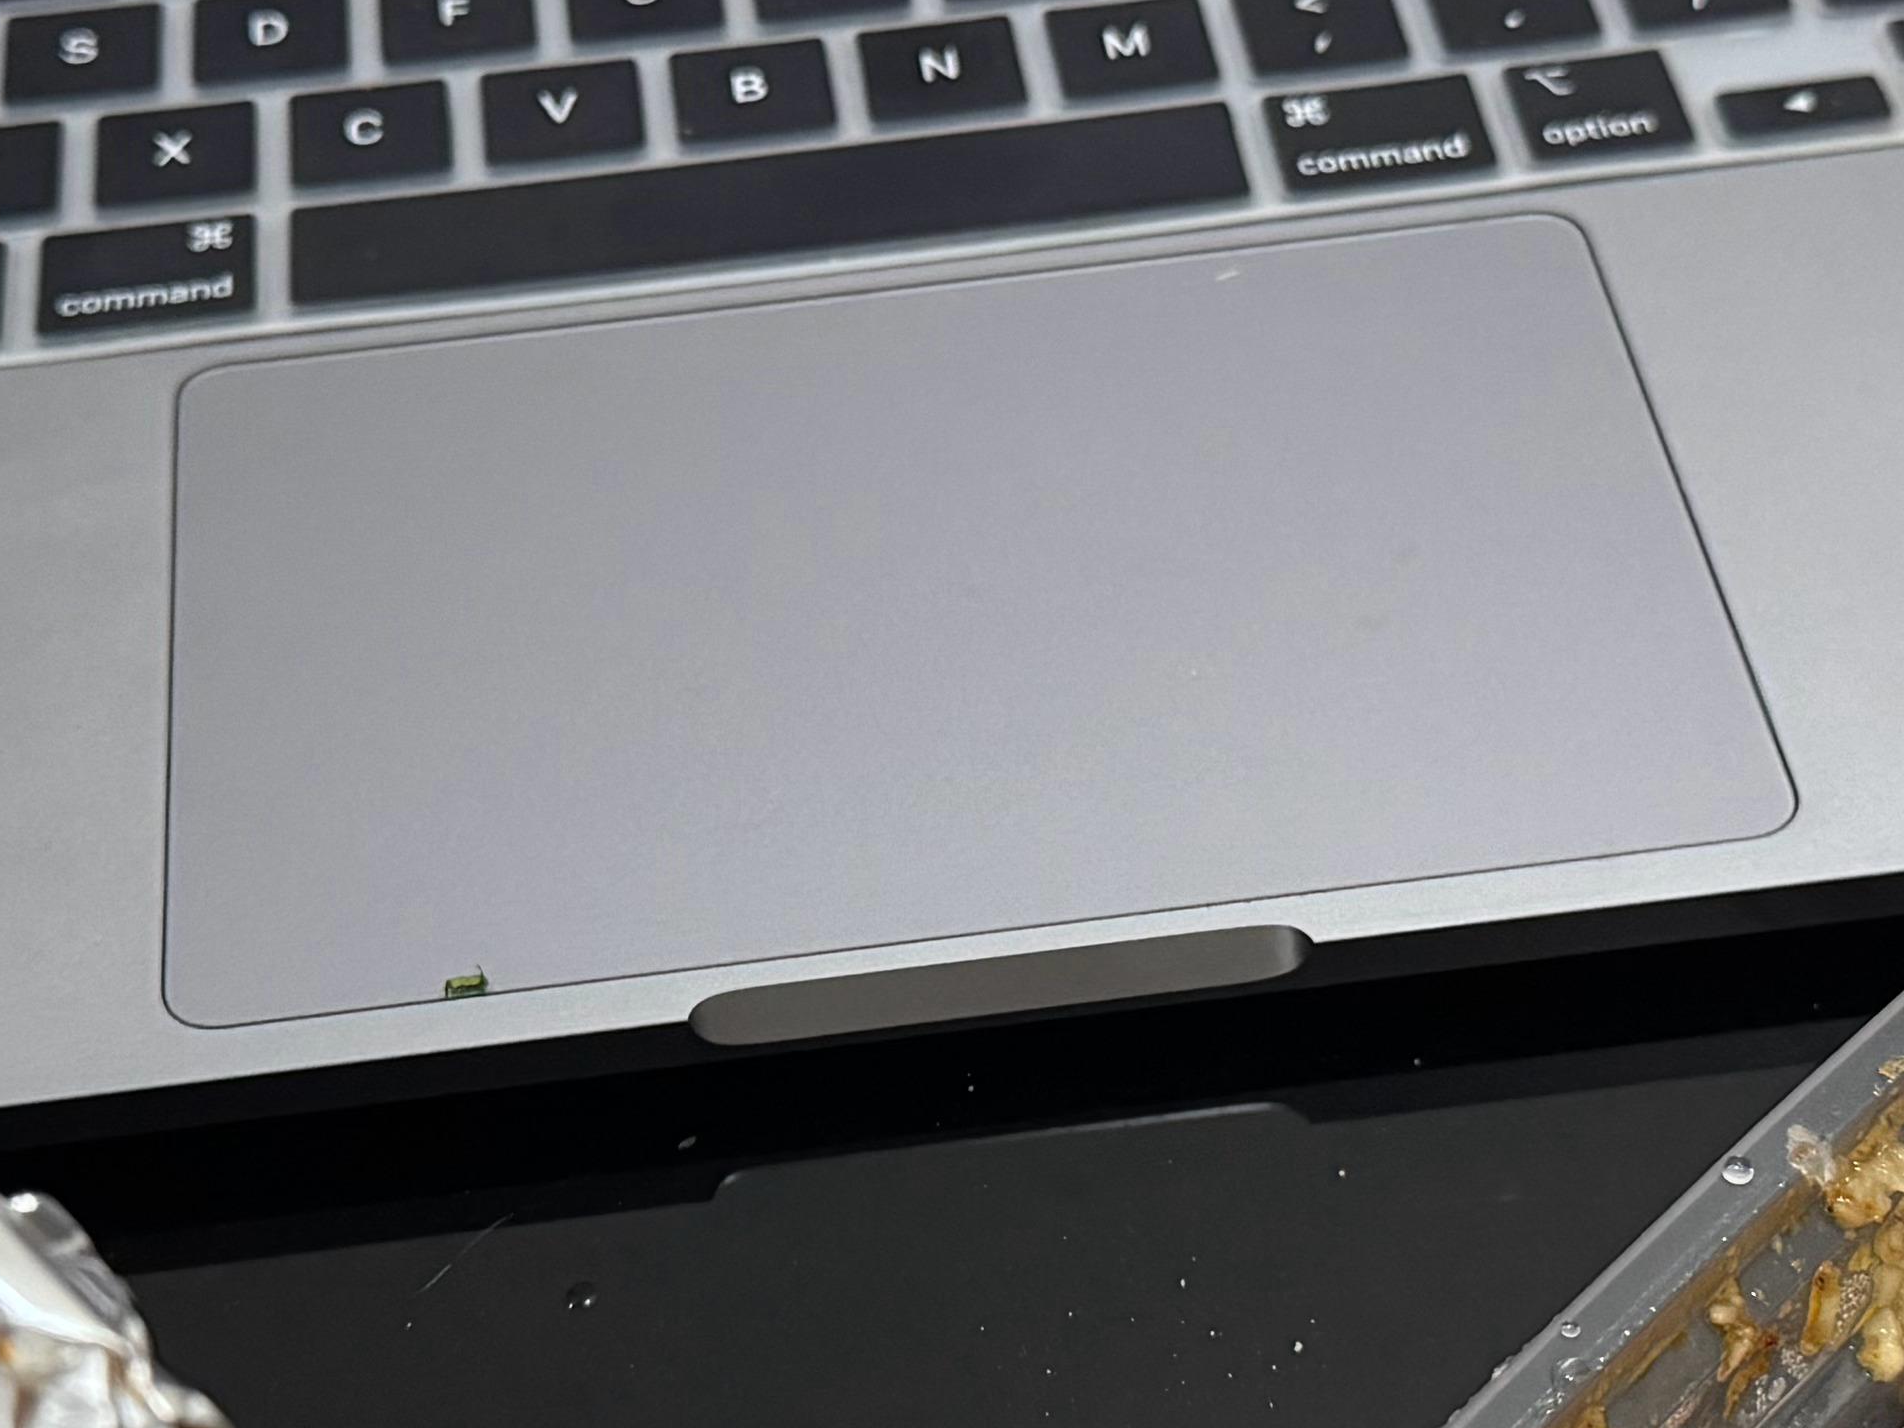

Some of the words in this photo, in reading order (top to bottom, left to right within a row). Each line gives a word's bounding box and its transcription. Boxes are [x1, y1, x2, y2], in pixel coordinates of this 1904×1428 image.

[60, 26, 100, 66] S
[248, 9, 290, 48] D
[154, 131, 192, 168] X
[343, 107, 384, 147] C
[538, 88, 579, 125] V
[729, 68, 769, 105] B
[918, 46, 961, 83] N
[1101, 22, 1151, 61] M
[56, 274, 234, 318] command
[1296, 132, 1470, 177] command
[1541, 113, 1657, 147] option
